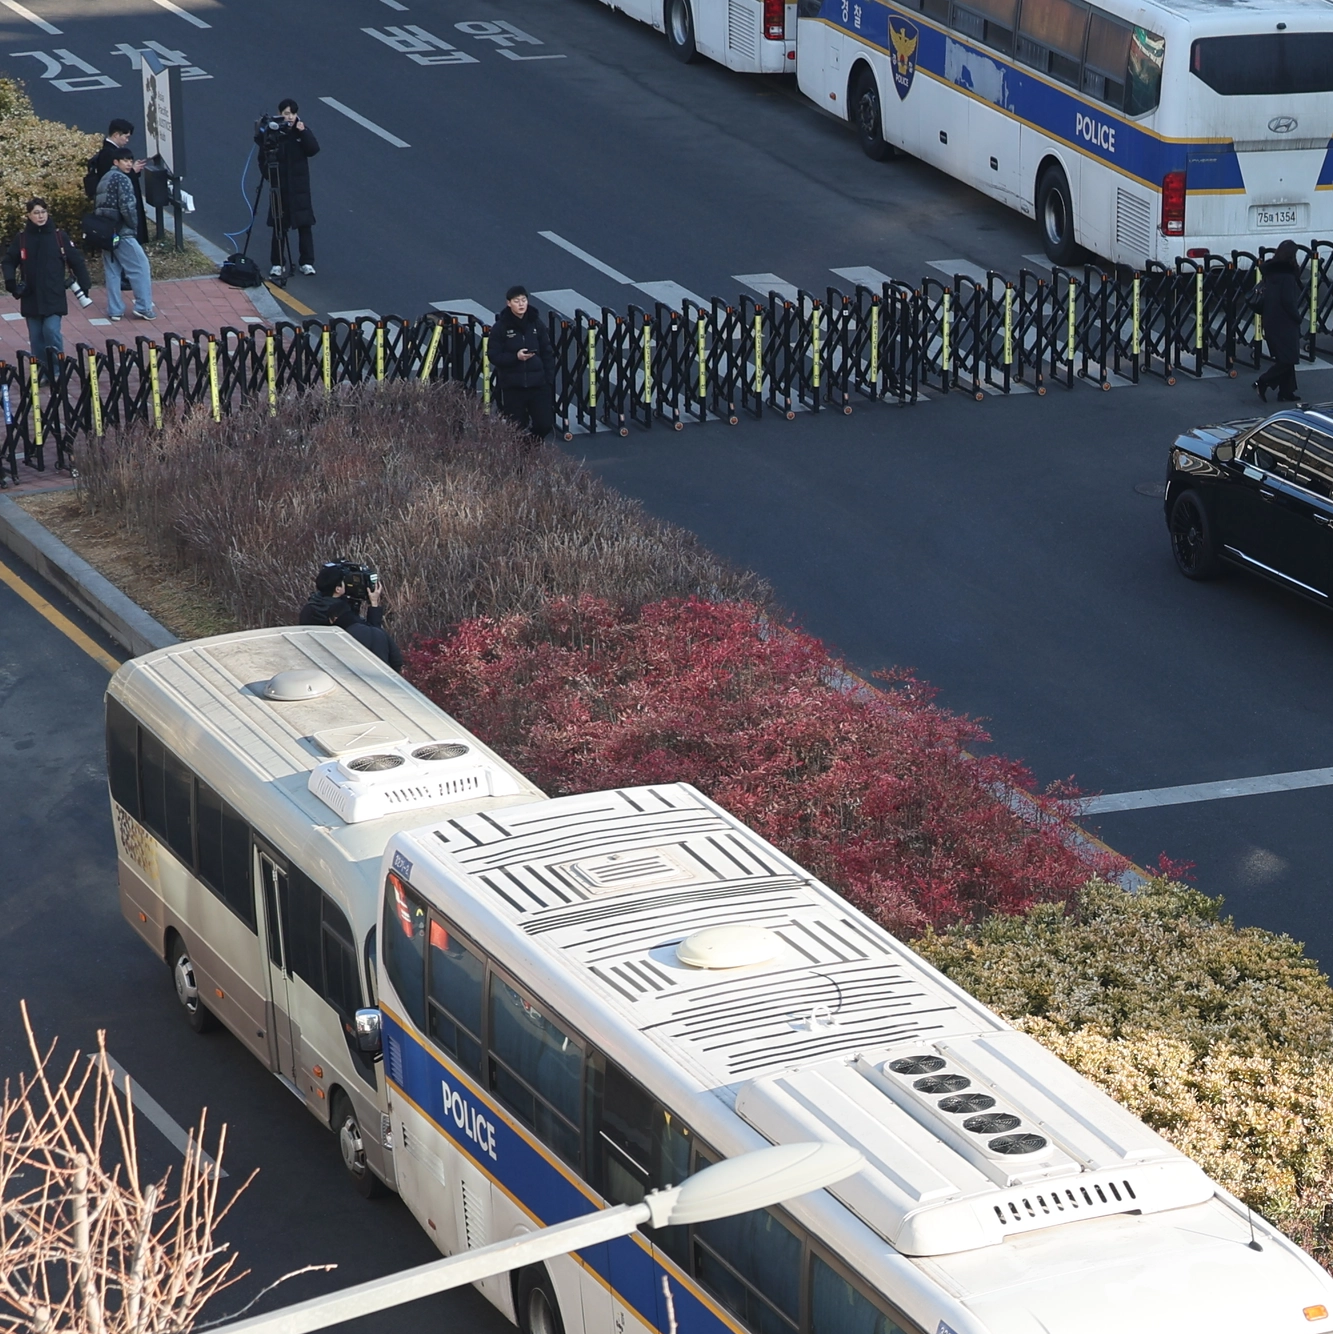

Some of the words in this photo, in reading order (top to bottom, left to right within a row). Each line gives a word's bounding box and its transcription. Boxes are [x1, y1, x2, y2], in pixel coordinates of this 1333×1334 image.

[360, 20, 567, 65] 법원
[895, 73, 909, 88] POLICE
[1076, 112, 1116, 153] POLICE
[1275, 211, 1296, 222] 1354
[441, 1080, 498, 1161] POLICE
